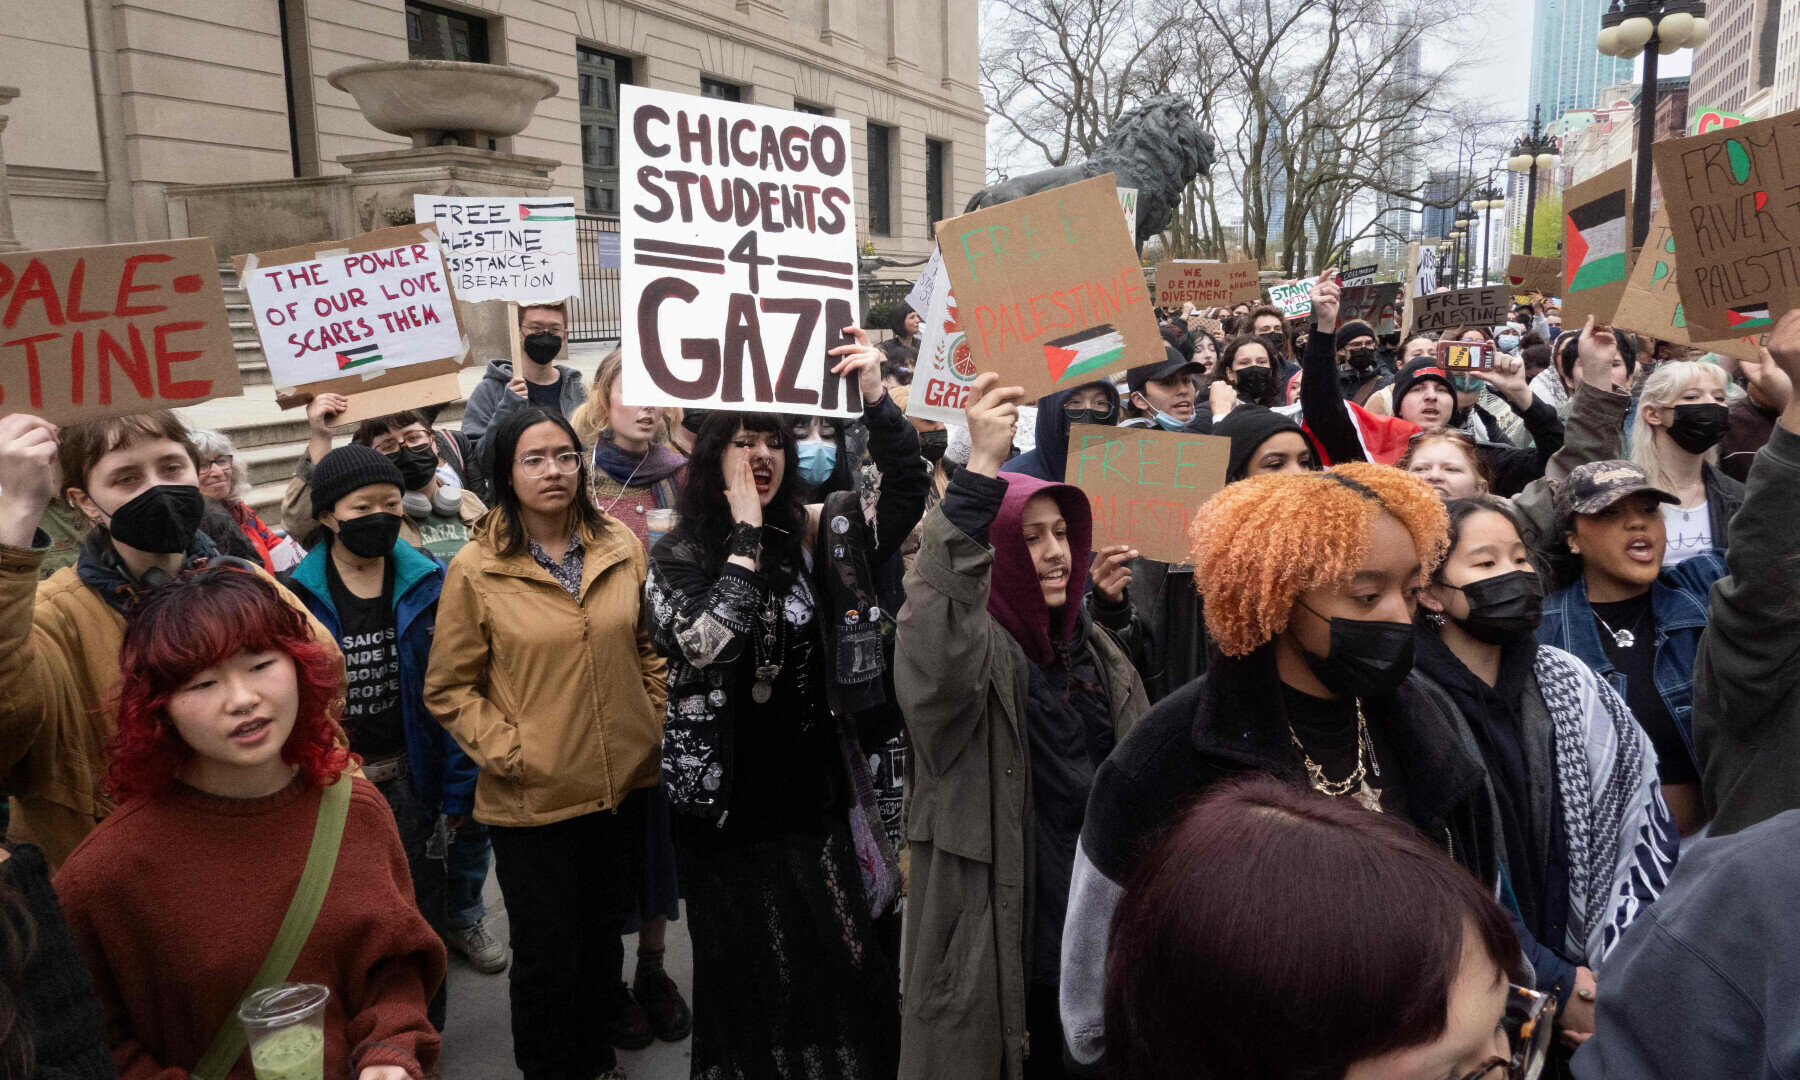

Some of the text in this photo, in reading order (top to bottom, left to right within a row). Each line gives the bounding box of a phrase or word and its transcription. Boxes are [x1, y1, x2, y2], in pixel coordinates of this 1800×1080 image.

[633, 104, 846, 177] CHICAGO
[1681, 126, 1784, 201] FROM
[433, 204, 511, 225] FREE
[634, 165, 851, 235] STUDENTS
[1690, 190, 1789, 258] RIVER
[441, 229, 543, 252] ALESTINE
[728, 231, 775, 294] 4
[960, 199, 1093, 283] FREE
[265, 244, 429, 293] THE POWER
[457, 271, 554, 290] IBERATION
[1162, 289, 1228, 303] DIVESTMENT
[1168, 279, 1221, 290] DEMAND
[1183, 268, 1202, 278] WE
[1272, 282, 1314, 301] STAND
[1695, 246, 1800, 309] PALESTI
[266, 271, 441, 326] OF OUR LOVE
[974, 267, 1146, 359] PALESTINE
[1282, 294, 1308, 306] WITH
[1417, 306, 1508, 330] PALESTINE
[1426, 290, 1495, 312] FREE
[288, 303, 441, 358] SCARES THEM
[637, 277, 864, 413] GAZA
[0, 320, 214, 410] TINE
[1079, 435, 1203, 489] FREE
[1089, 495, 1195, 550] ALESTIN
